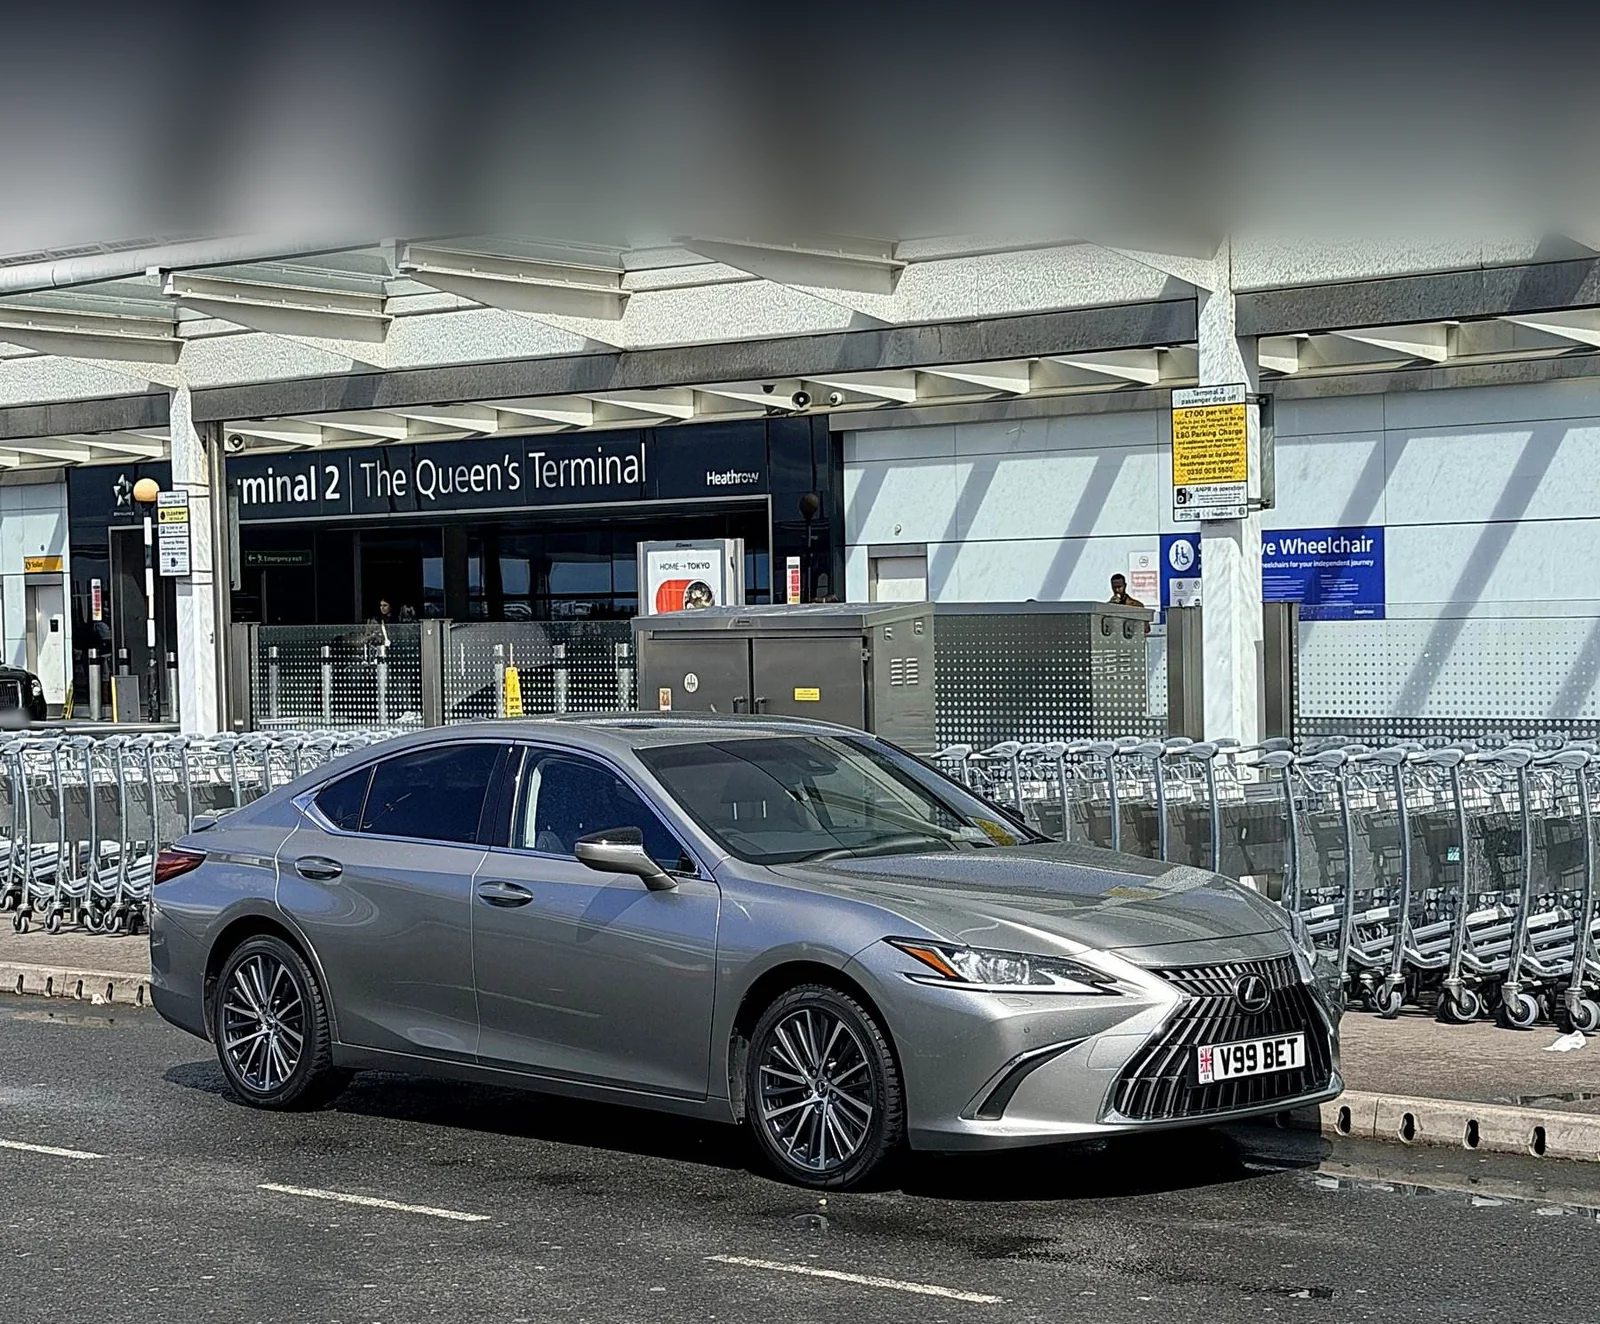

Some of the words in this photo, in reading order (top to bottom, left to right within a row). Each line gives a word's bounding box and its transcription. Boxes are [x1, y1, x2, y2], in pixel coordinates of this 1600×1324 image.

[238, 466, 316, 504] minal
[325, 466, 341, 499] 2
[360, 459, 407, 498] The
[416, 454, 520, 500] Queen's
[528, 443, 646, 489] Terminal
[706, 469, 759, 486] Heathrow
[1280, 535, 1374, 554] Wheelchair
[660, 562, 680, 570] HOME
[687, 562, 710, 570] TOKYO
[1314, 560, 1350, 568] independent
[1350, 559, 1374, 568] journey
[1220, 1044, 1257, 1075] V99
[1263, 1038, 1298, 1069] BET
